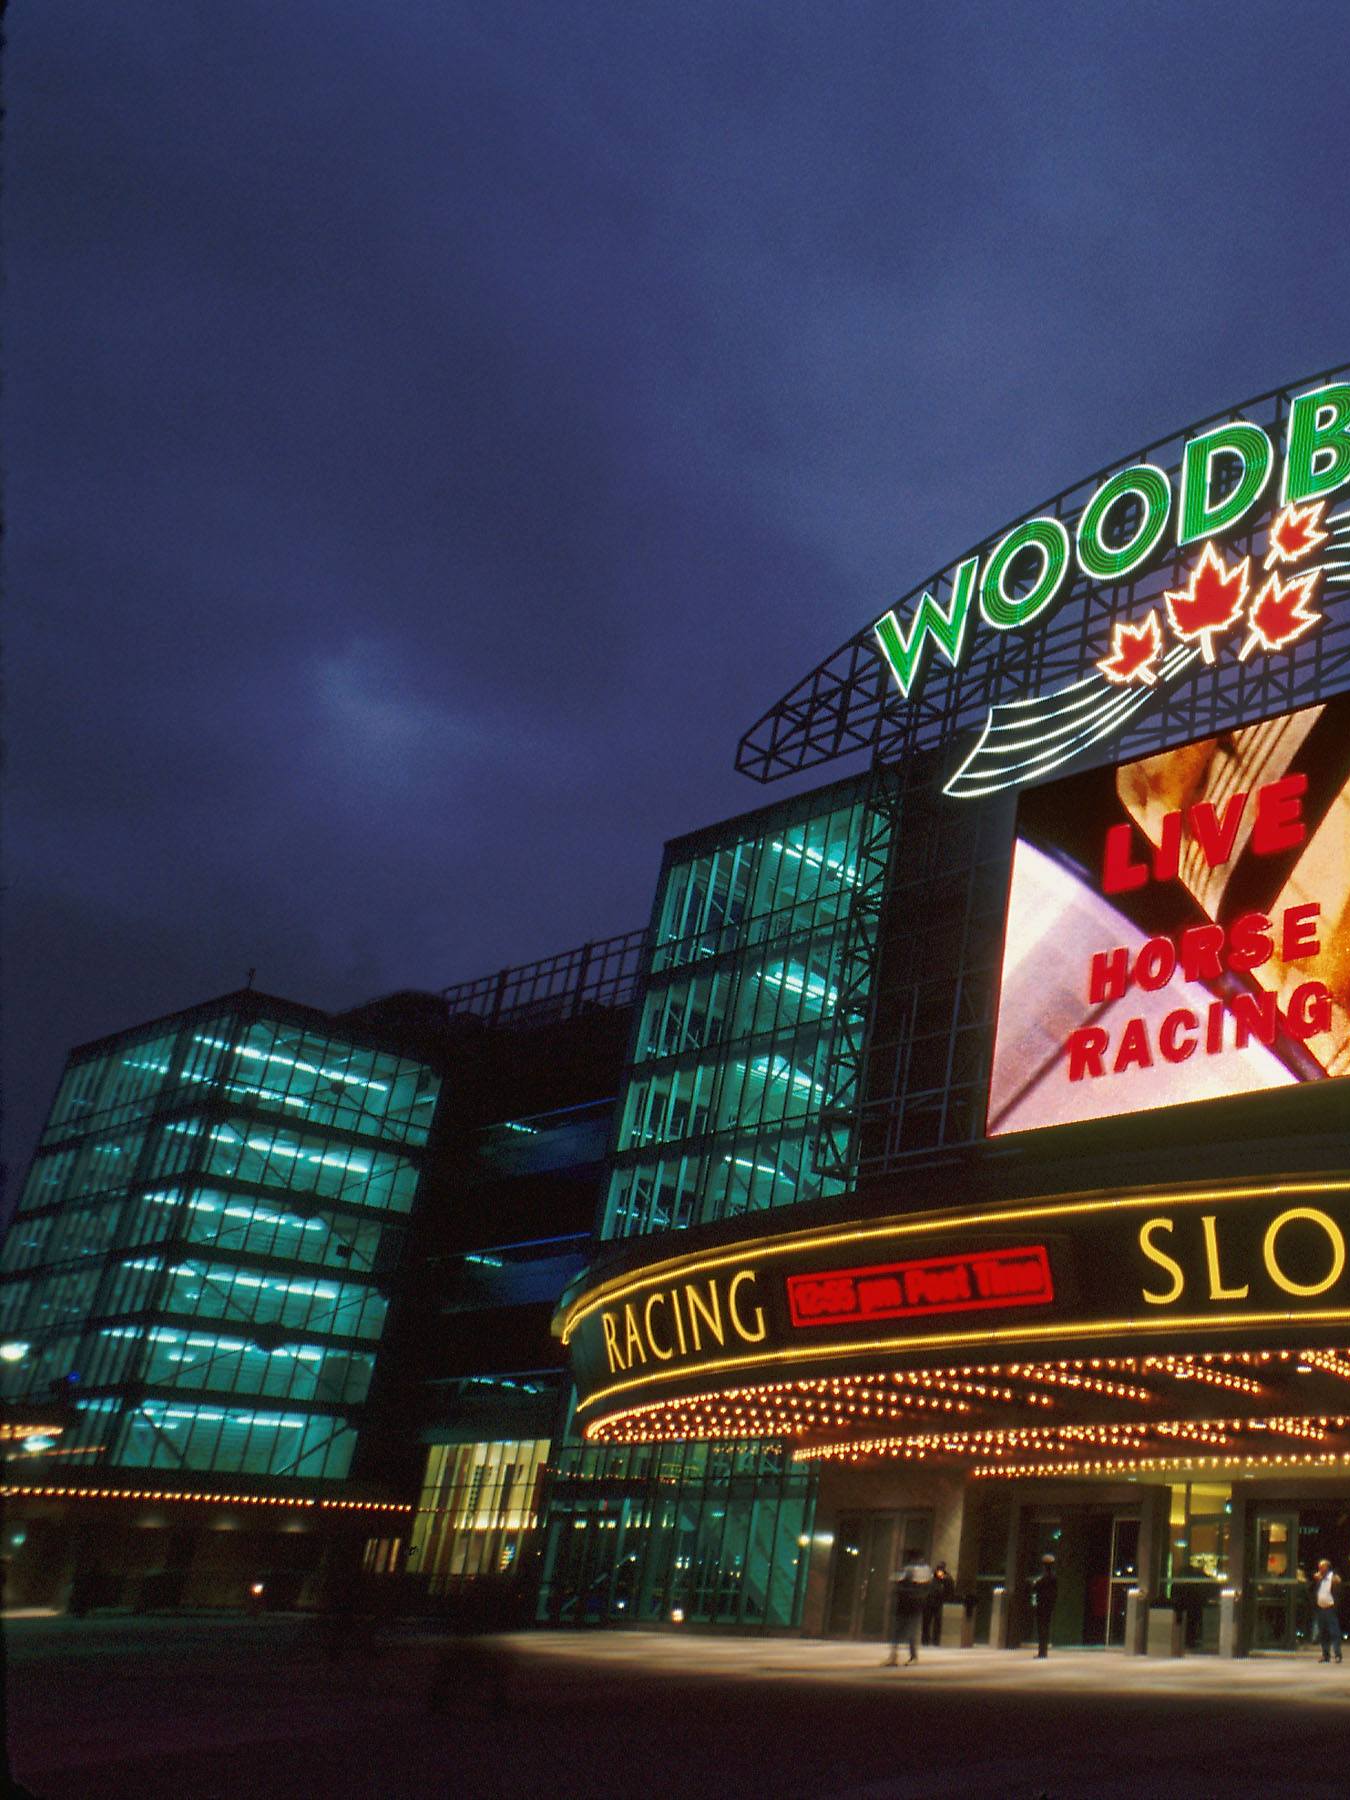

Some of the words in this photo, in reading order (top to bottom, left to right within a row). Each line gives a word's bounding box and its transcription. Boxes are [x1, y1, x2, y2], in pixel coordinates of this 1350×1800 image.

[1103, 773, 1307, 893] LIVE
[1089, 903, 1321, 1004] HORSE
[1068, 981, 1332, 1081] RACING
[602, 1270, 766, 1374] RACING
